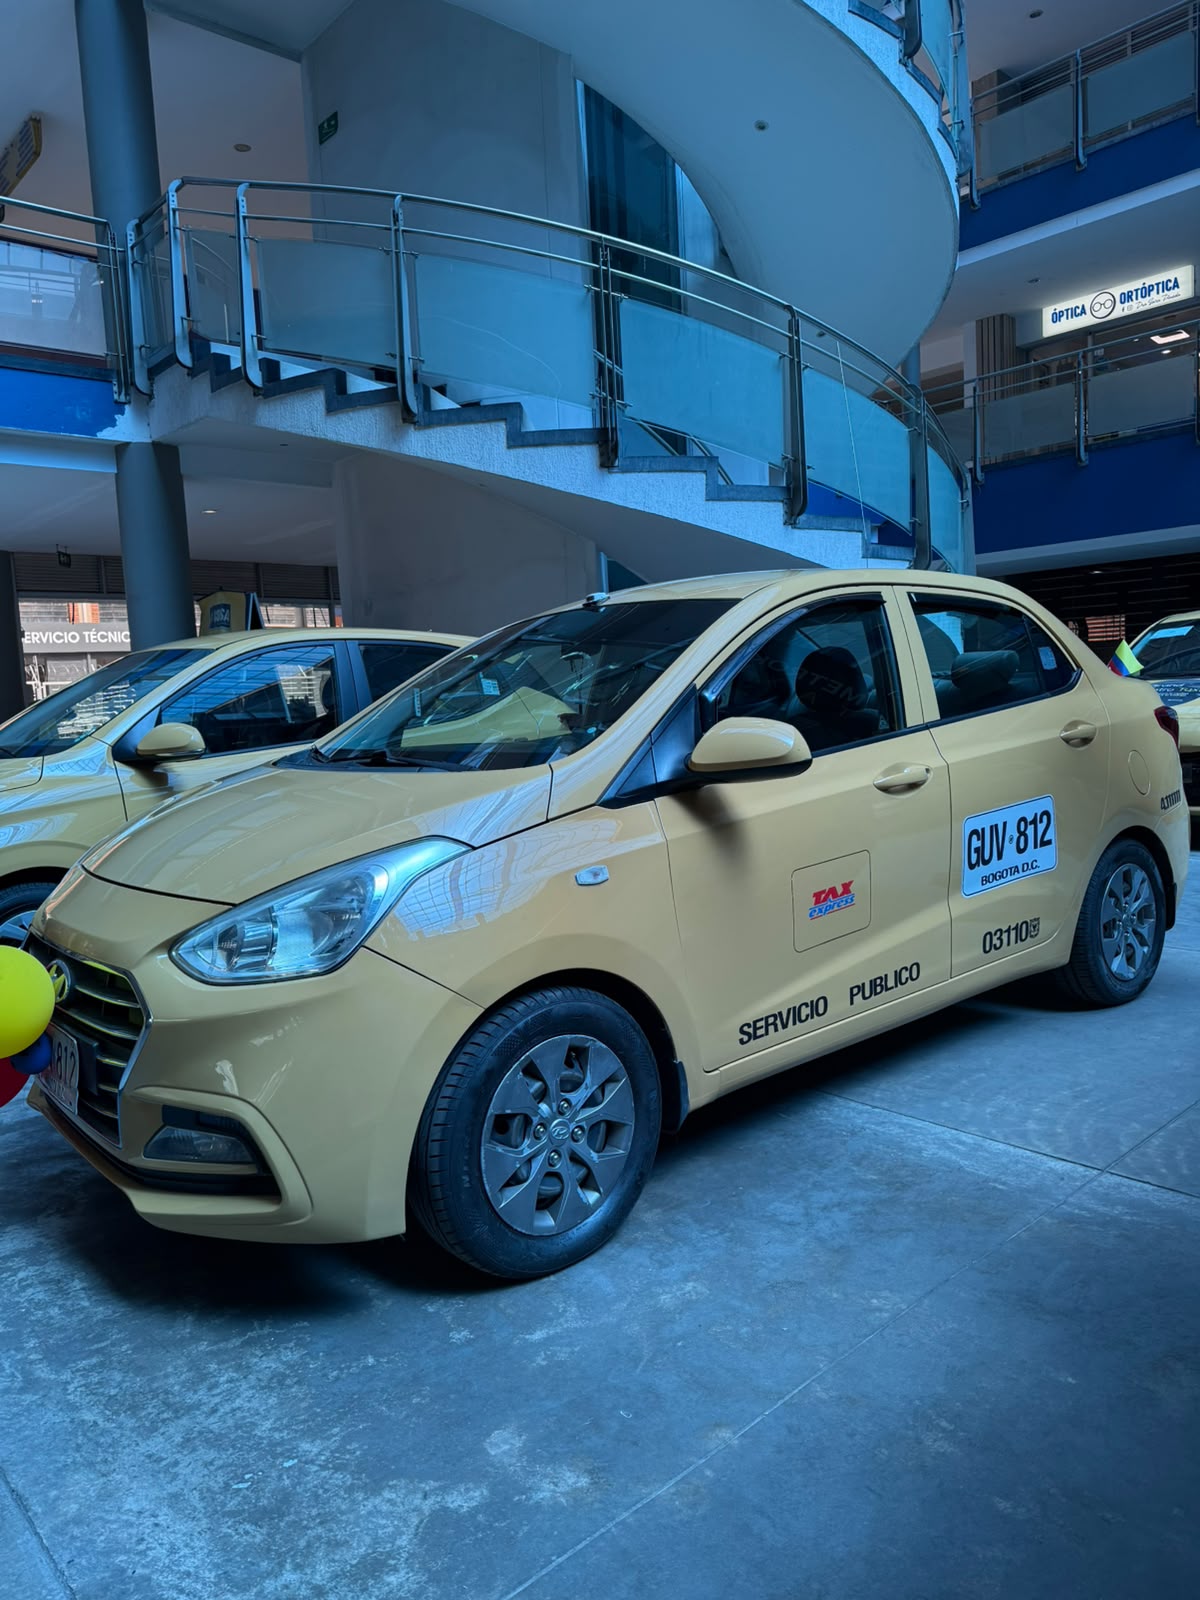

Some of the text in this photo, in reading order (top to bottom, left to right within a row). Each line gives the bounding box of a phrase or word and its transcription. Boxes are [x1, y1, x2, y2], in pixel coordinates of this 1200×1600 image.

[1051, 277, 1180, 324] ÓPTICA ORTÓPTICA
[83, 629, 131, 644] TÉCNIC
[967, 810, 1053, 871] GUV 812
[981, 860, 1040, 886] BOGOTA D.C.
[808, 895, 855, 918] express
[812, 880, 854, 906] TAX
[982, 920, 1029, 954] 03110
[739, 962, 921, 1045] SERVICIO PUBLICO
